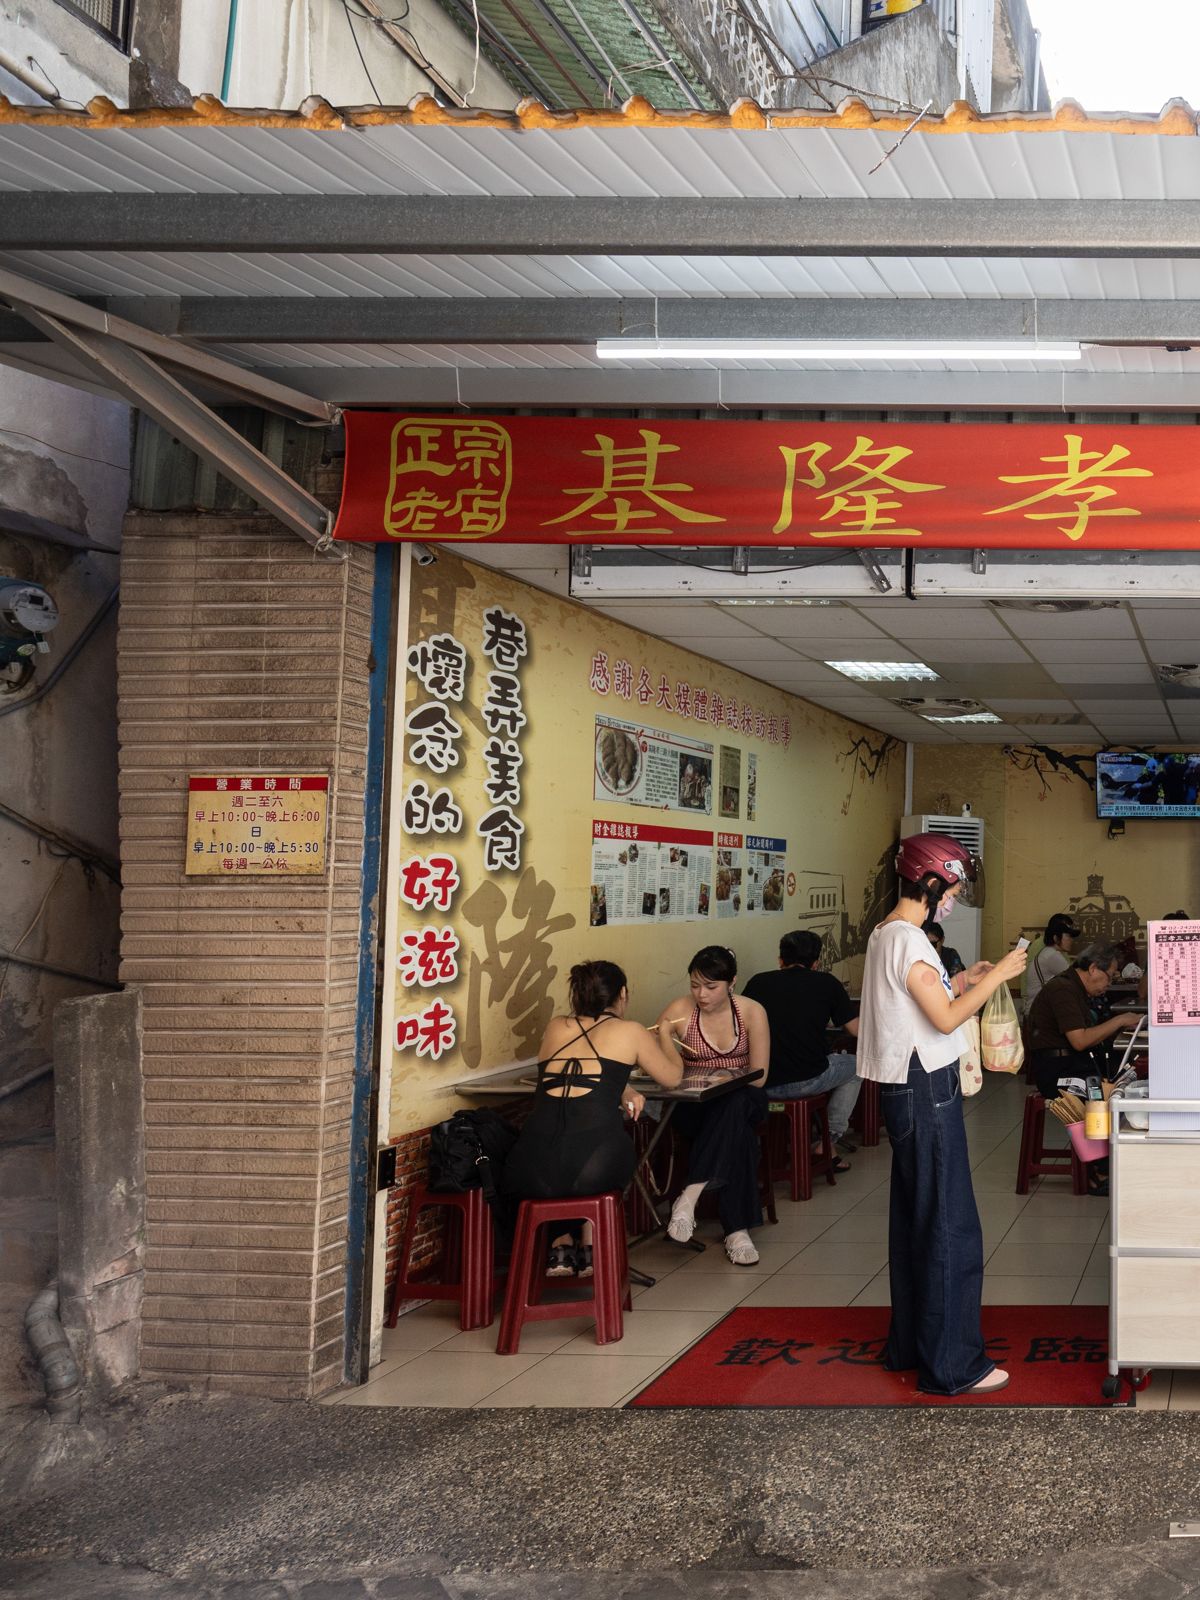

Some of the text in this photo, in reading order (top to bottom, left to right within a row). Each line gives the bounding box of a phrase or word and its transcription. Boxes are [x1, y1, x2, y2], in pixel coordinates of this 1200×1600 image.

[395, 425, 507, 479] 正宗
[390, 482, 506, 533] 老店
[590, 652, 793, 750] 感謝各大媒體雜誌採訪報導
[476, 604, 528, 872] 巷弄美食
[216, 778, 302, 791] 營業時間
[231, 795, 284, 808] 週二至六
[251, 826, 262, 838] 日
[395, 633, 466, 1060] 懷念的好滋味
[222, 858, 288, 870] 每週一公休
[715, 1337, 1109, 1366] 歡迎臨
